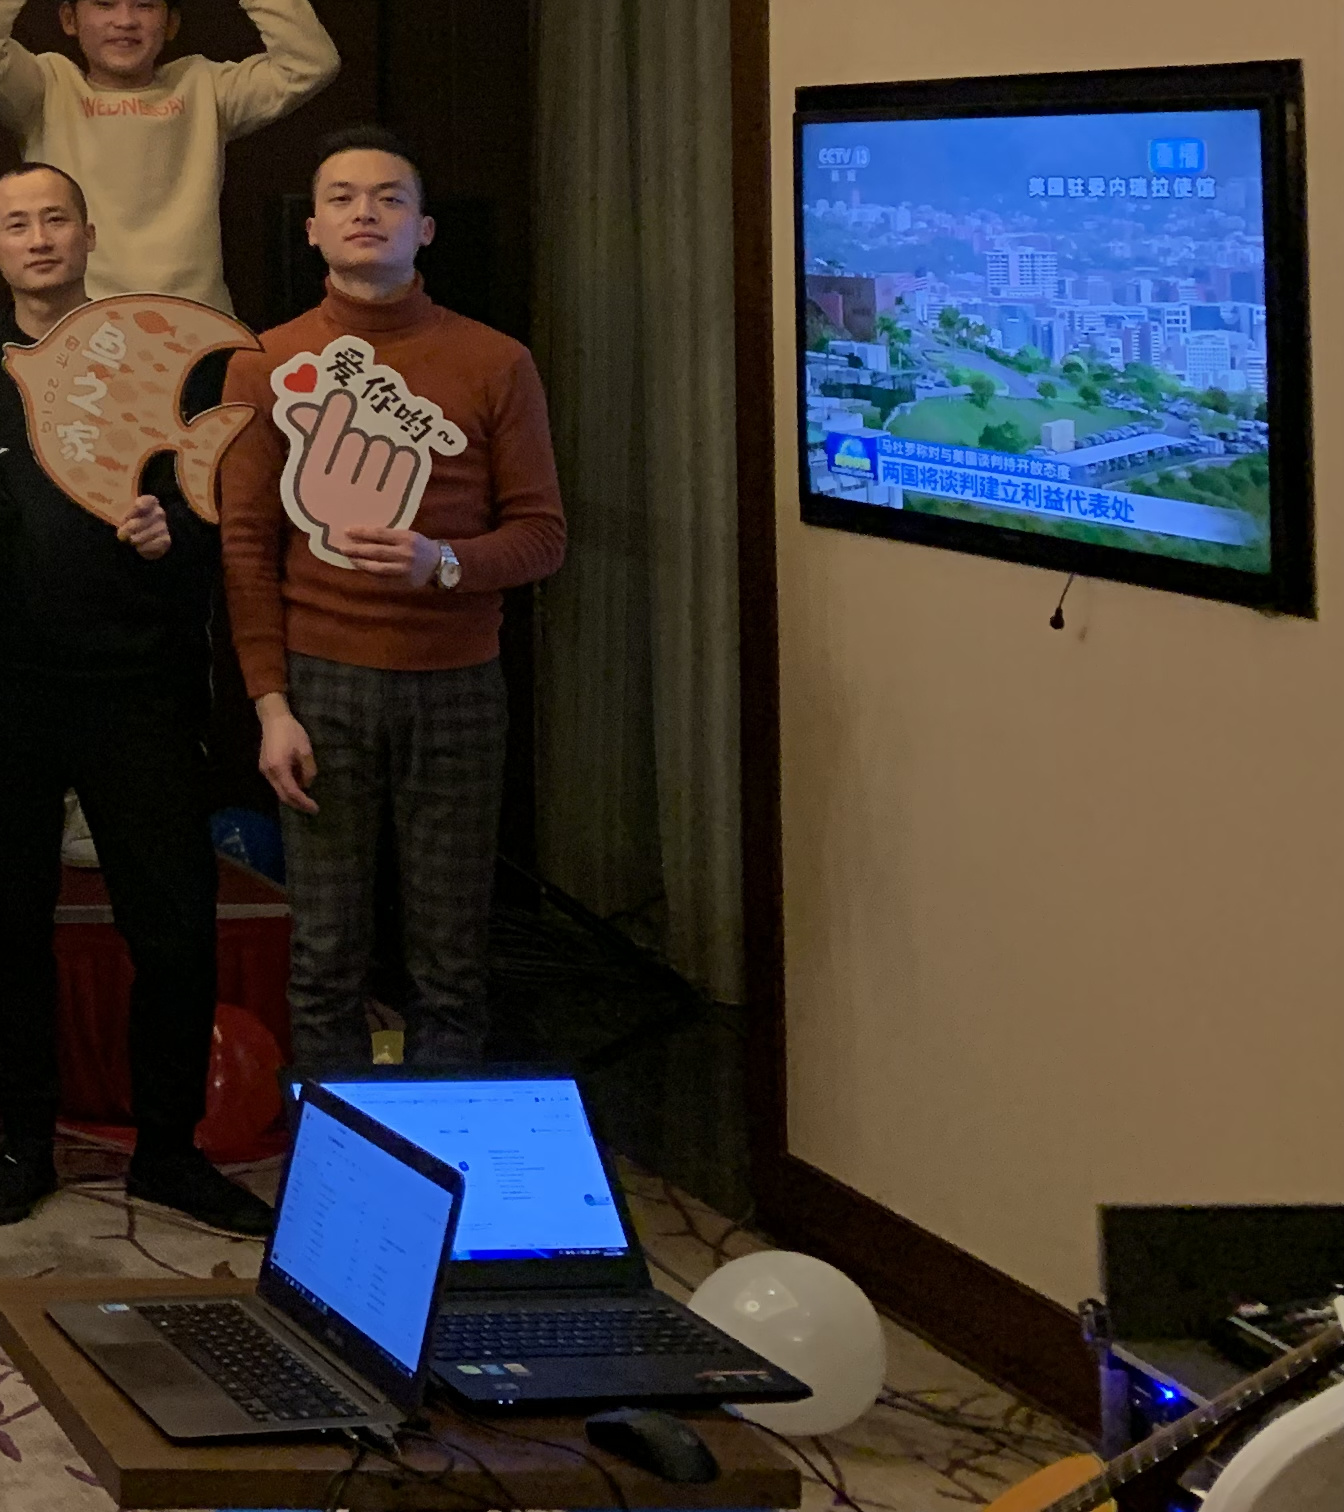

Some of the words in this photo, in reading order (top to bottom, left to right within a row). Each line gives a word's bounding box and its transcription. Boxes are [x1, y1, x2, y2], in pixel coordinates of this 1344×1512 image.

[881, 460, 1135, 524] 两国将谈判建立利益代表处
